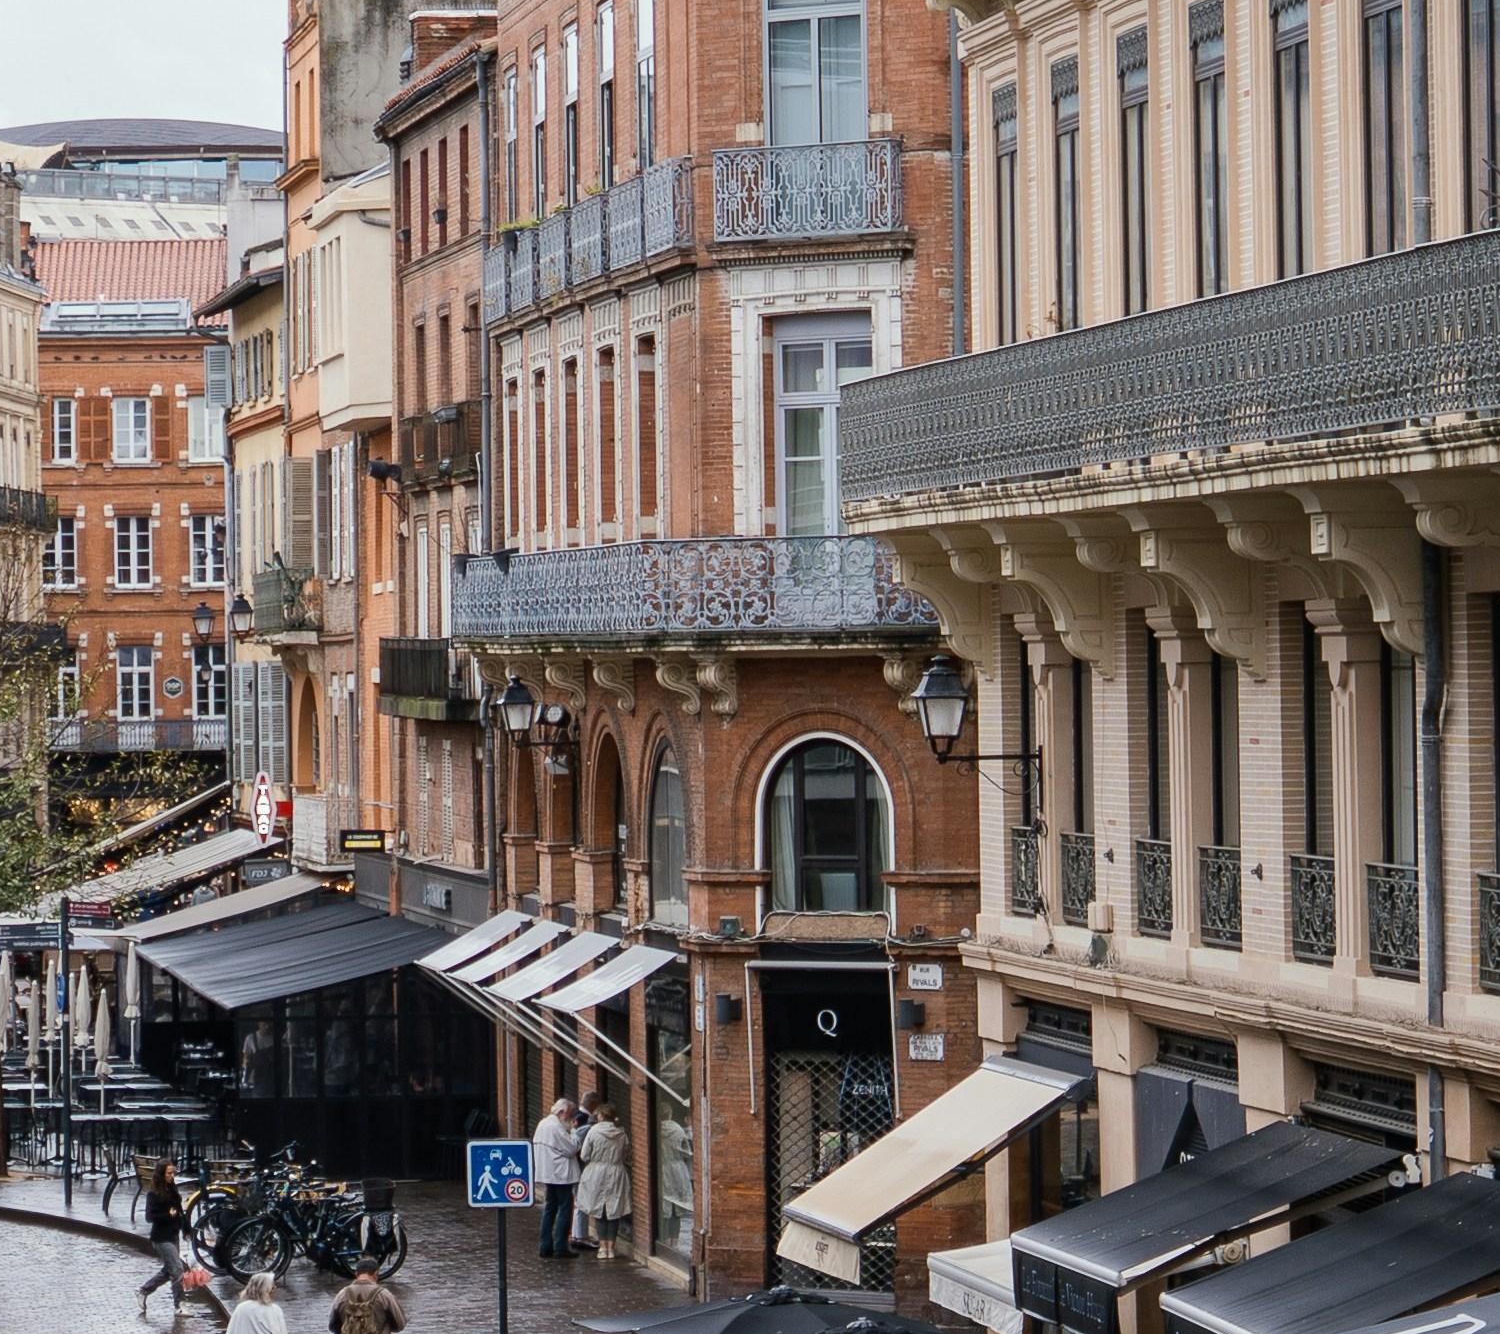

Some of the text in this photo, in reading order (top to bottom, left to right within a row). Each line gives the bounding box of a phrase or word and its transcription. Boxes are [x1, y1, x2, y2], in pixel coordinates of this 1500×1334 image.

[256, 784, 271, 835] TABAC
[250, 868, 269, 879] FDJ
[912, 978, 938, 987] RIVALS
[817, 1009, 838, 1038] Q
[913, 1045, 939, 1054] RIVALS
[851, 1082, 889, 1097] ZENITH
[510, 1185, 524, 1195] 20
